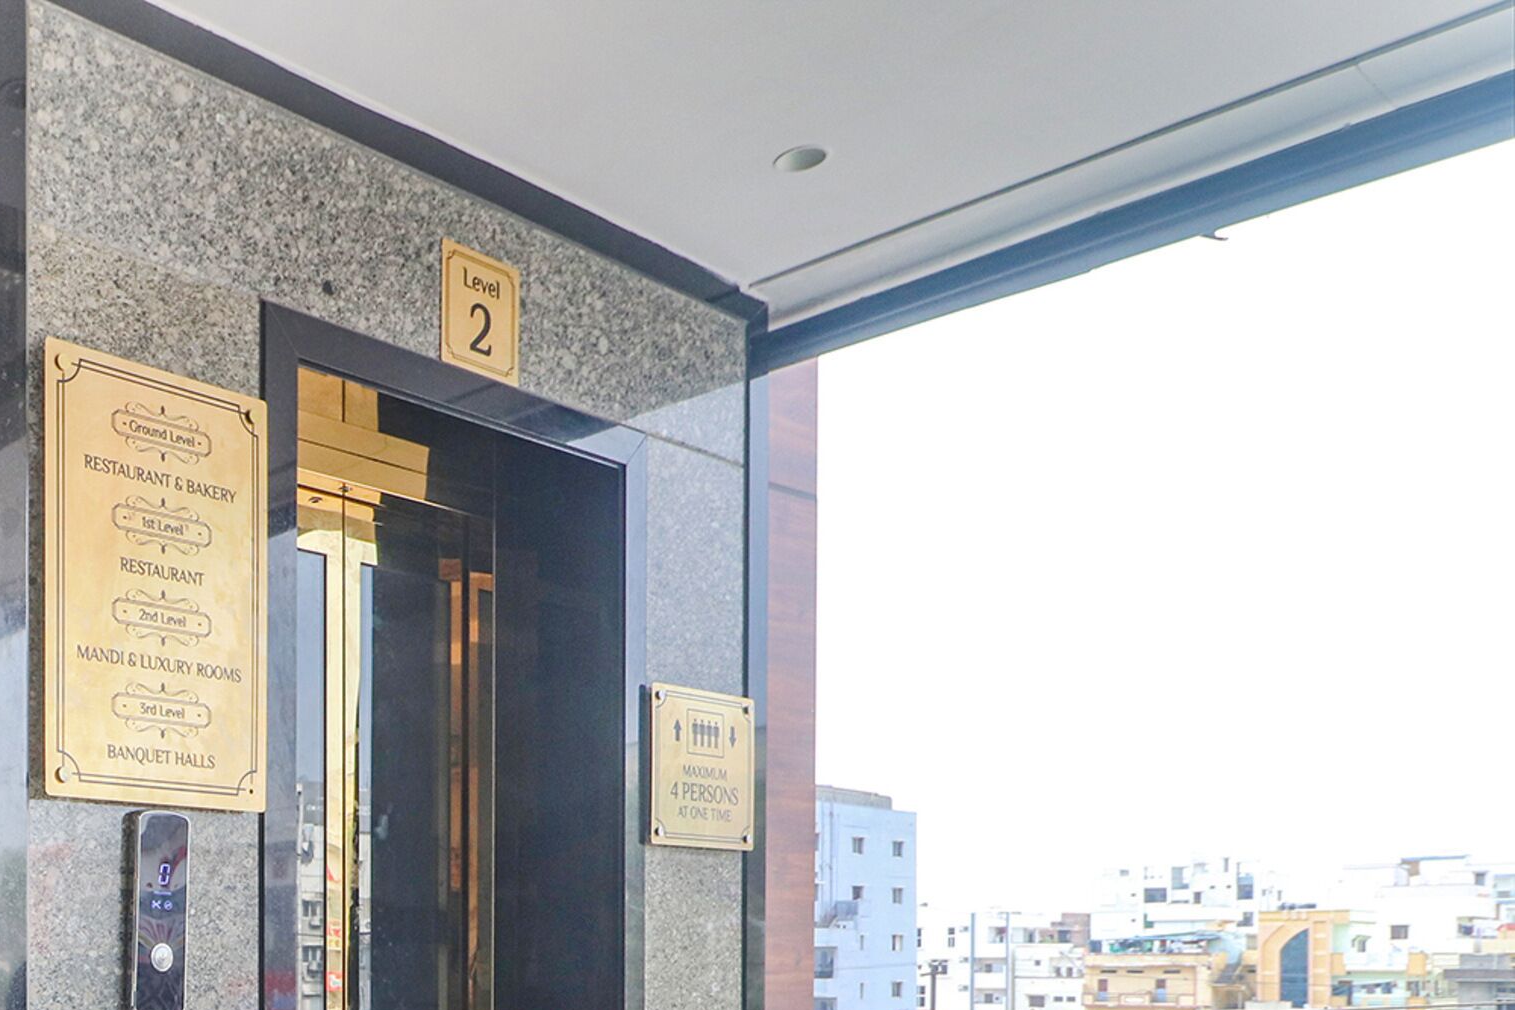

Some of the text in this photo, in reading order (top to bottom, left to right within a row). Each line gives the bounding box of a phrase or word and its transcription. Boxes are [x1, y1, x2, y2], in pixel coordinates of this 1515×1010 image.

[463, 266, 500, 300] Level
[469, 302, 492, 357] 2
[128, 419, 196, 448] Ground Level
[84, 453, 237, 504] RESTAURANT & BAKERY
[141, 515, 184, 537] 1st Level
[120, 556, 205, 587] RESTAURANT
[138, 608, 187, 628] 2nd Level
[76, 644, 242, 684] MANDI & LUXURY ROOMS
[139, 701, 185, 720] 3rd Level
[107, 743, 216, 770] BANQUET HALLS
[683, 764, 727, 781] MAXIMUM
[670, 781, 739, 806] 4 PERSONS
[678, 806, 732, 822] AT ONE TIME
